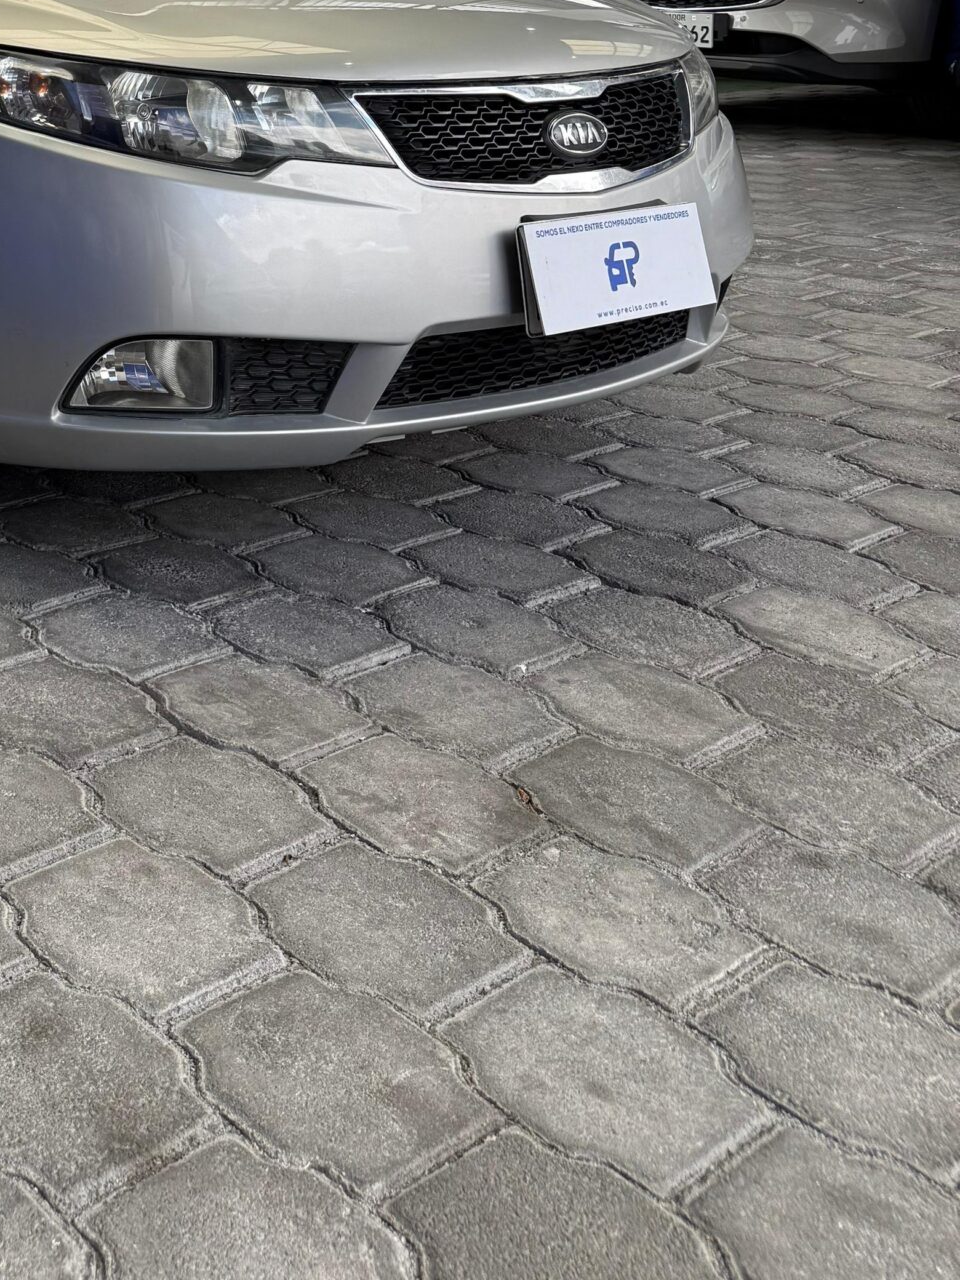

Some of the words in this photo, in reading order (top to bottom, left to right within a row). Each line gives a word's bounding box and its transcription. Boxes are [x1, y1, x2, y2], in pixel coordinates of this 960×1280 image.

[558, 121, 602, 146] KIA
[535, 227, 558, 238] SOMOS
[559, 226, 567, 235] EL
[567, 224, 584, 234] NEXO
[584, 222, 604, 231] ENTRE
[604, 216, 648, 229] COMPRADORES
[653, 210, 689, 222] VENDEDORES
[597, 300, 669, 318] www.preciso.com.ec
